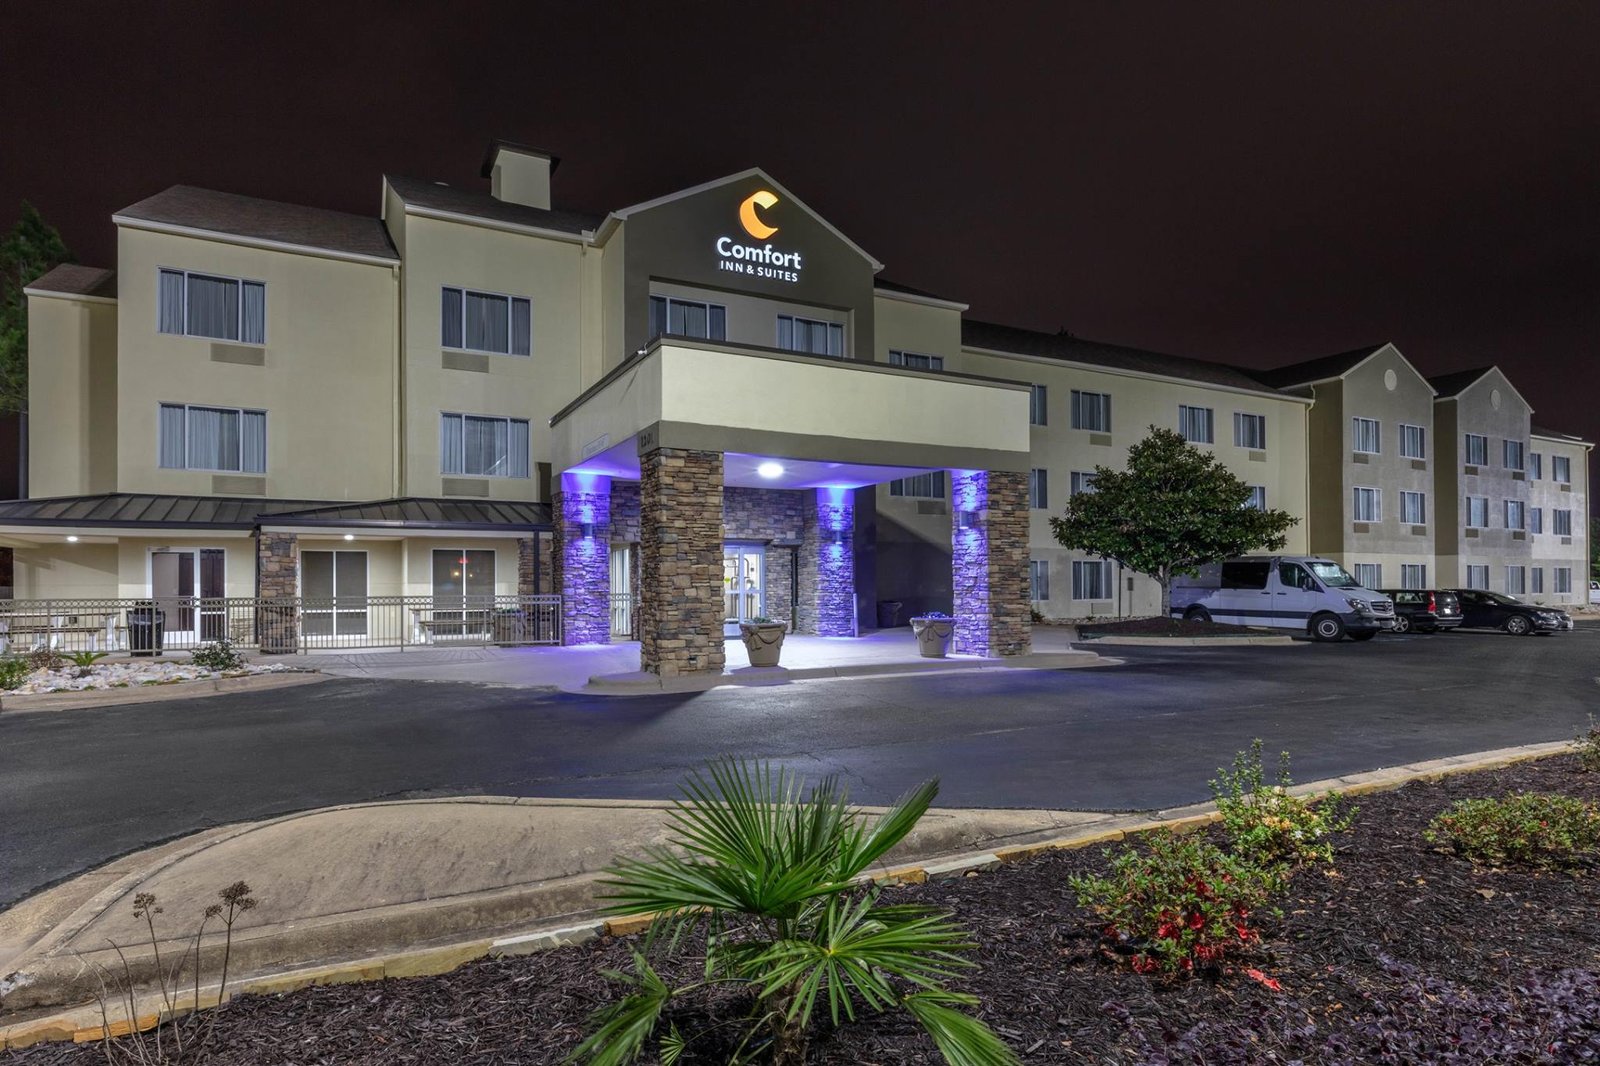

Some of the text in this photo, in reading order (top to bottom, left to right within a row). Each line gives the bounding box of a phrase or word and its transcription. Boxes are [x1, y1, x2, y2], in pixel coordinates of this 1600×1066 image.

[716, 236, 801, 269] Comfort
[720, 260, 798, 282] INN & SUITES
